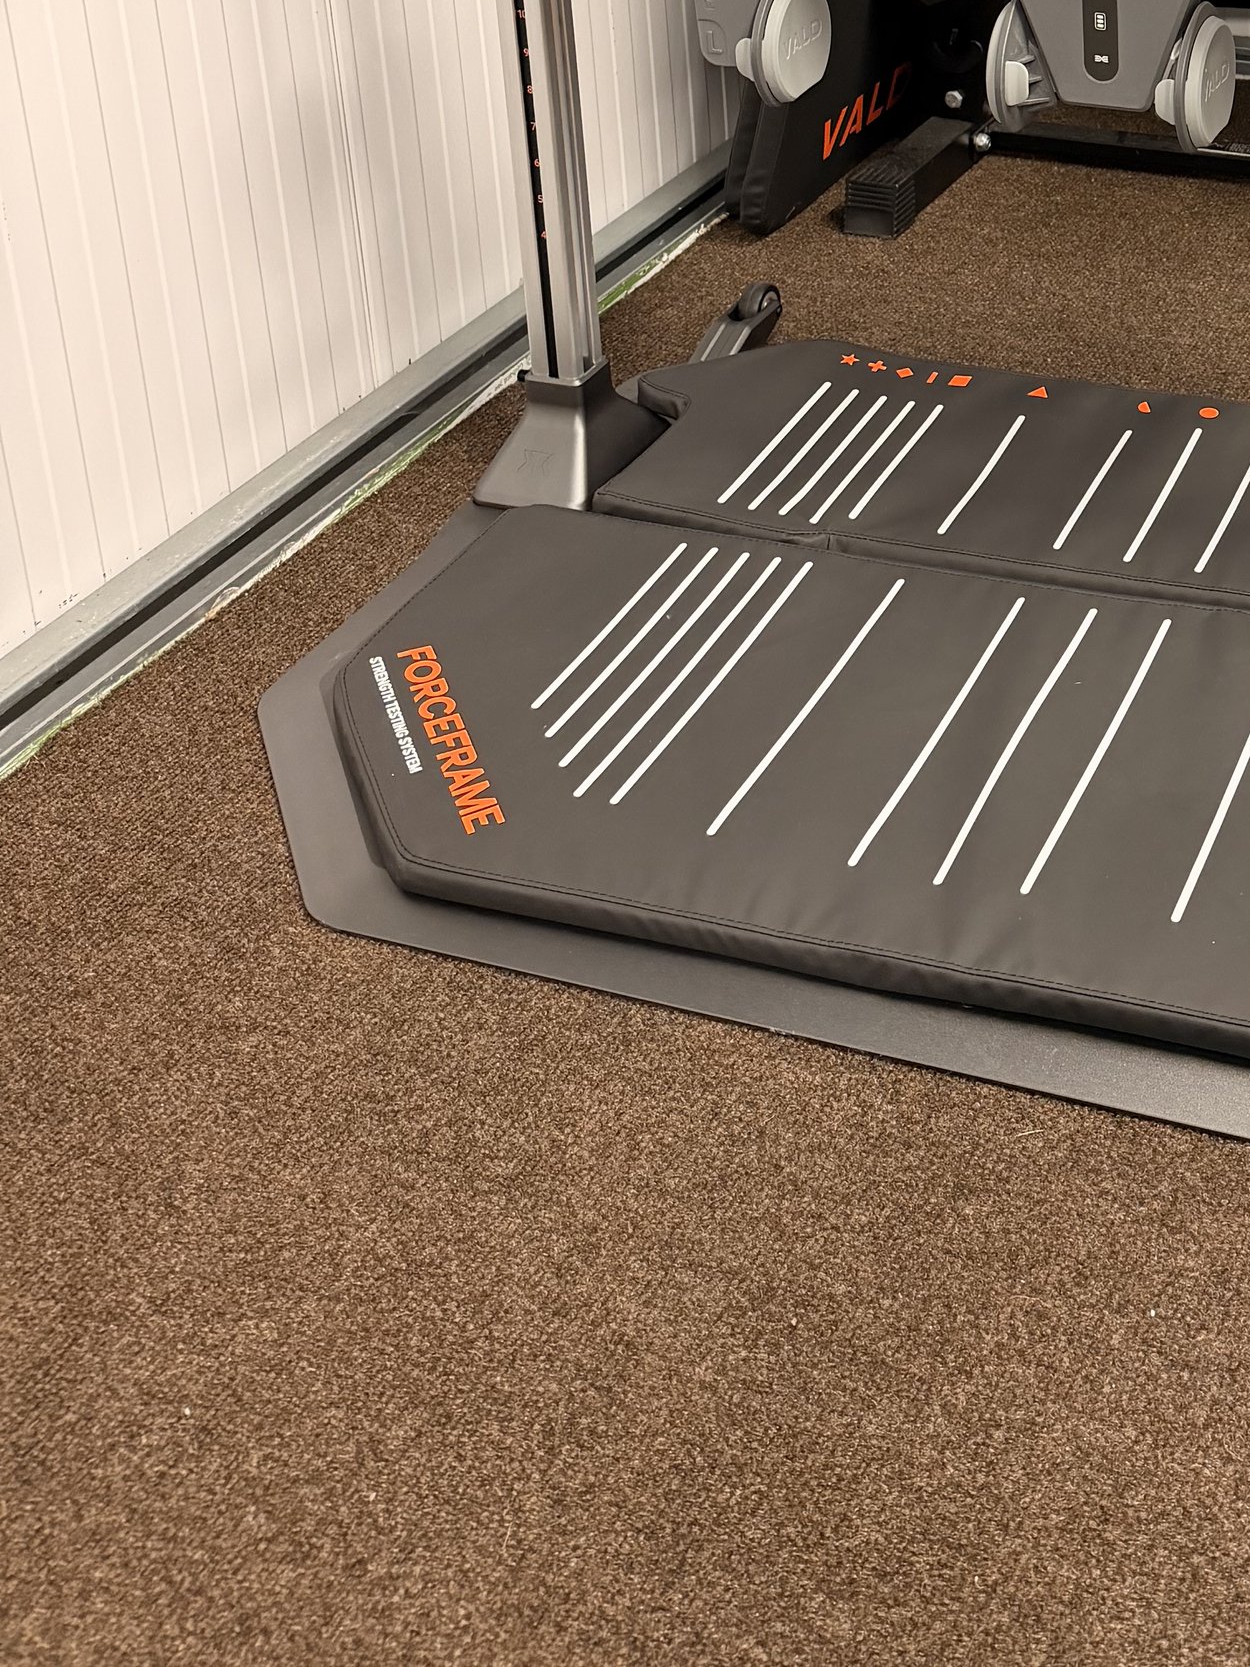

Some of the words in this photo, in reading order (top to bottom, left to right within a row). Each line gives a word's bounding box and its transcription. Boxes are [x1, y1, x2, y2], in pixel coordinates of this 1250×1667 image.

[706, 29, 723, 56] L
[785, 19, 824, 60] VALD
[822, 62, 912, 161] VALD
[369, 656, 396, 704] STRENGTH
[385, 700, 410, 739] TESTING
[398, 736, 423, 775] SYSTEM
[396, 645, 506, 836] FORCEFRAME
